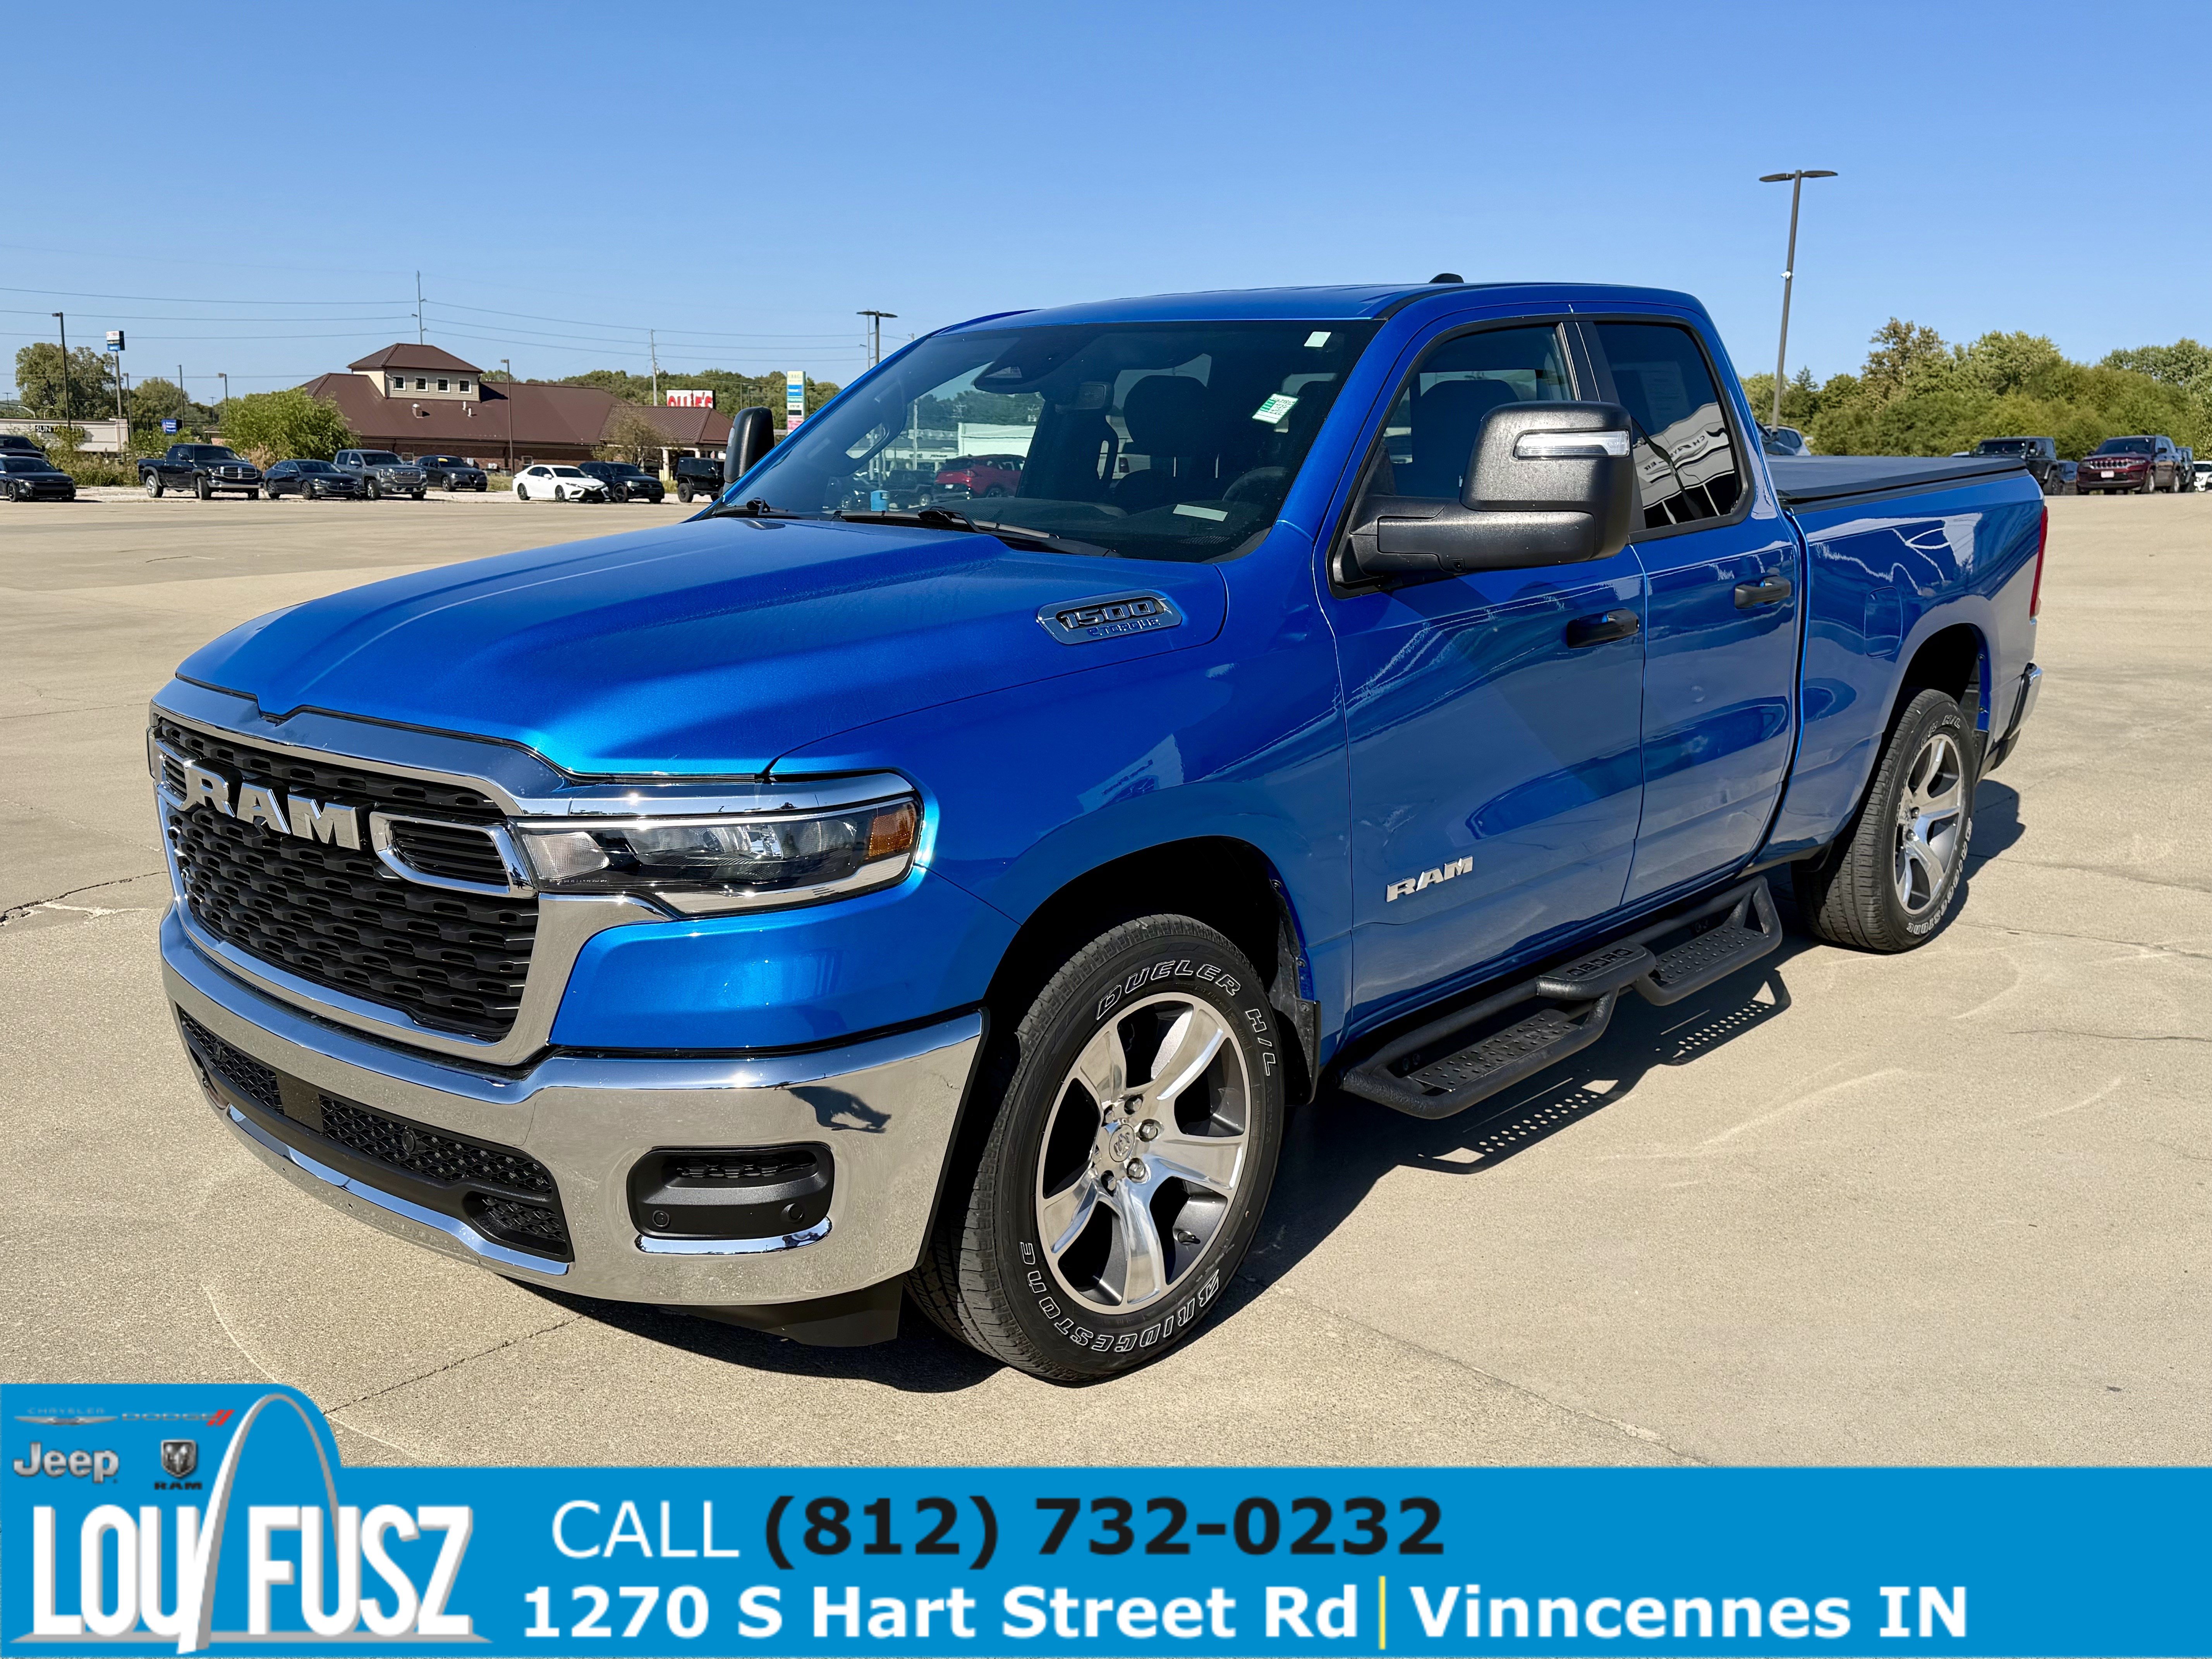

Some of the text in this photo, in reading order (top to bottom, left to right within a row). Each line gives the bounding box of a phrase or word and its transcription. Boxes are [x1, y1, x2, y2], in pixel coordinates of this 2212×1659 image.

[1060, 599, 1157, 629] 1500
[182, 761, 362, 850] RAM
[1386, 855, 1473, 902] RAM
[1096, 960, 1241, 1020] DUELER
[1245, 1008, 1276, 1076] H/L
[1020, 1242, 1219, 1352] BRIDGESTONE
